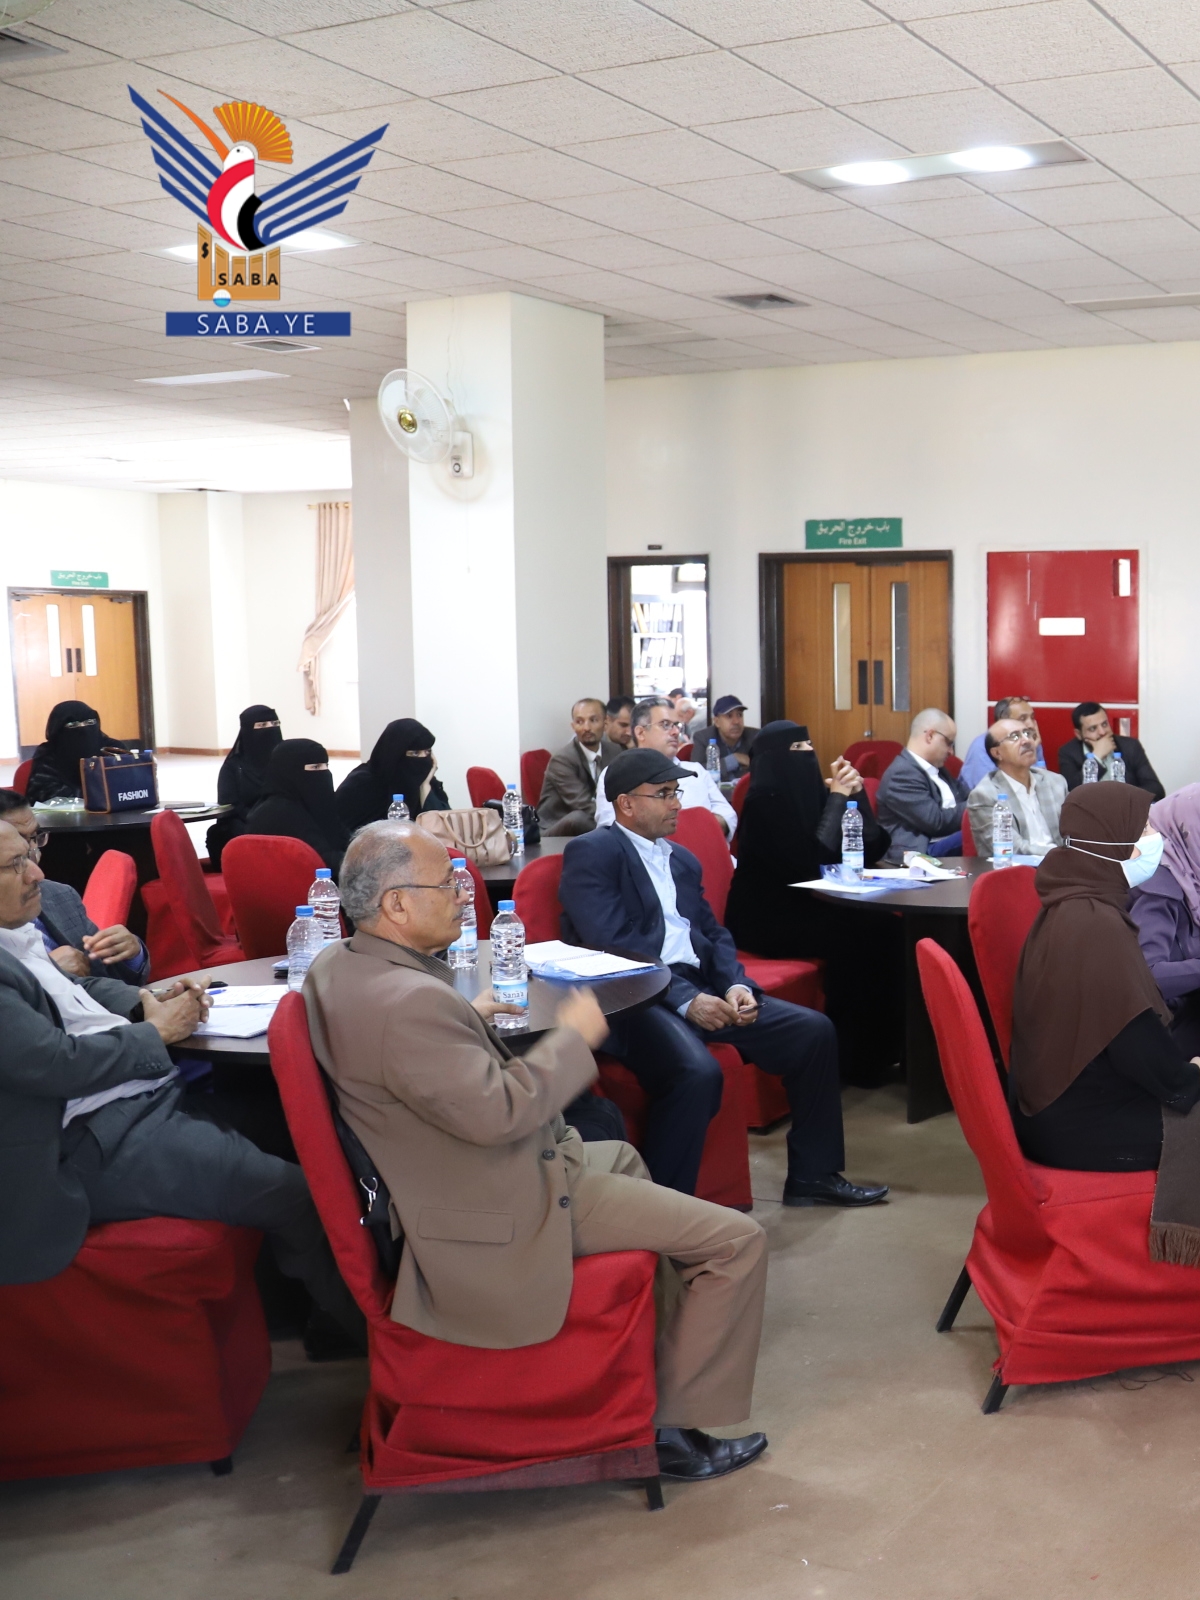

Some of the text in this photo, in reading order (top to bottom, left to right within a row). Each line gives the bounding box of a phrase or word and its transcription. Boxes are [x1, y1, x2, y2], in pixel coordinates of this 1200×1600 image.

[847, 522, 874, 537] خروج
[876, 521, 890, 533] باب
[838, 537, 867, 545] Fire Exit
[117, 789, 149, 802] FASHION
